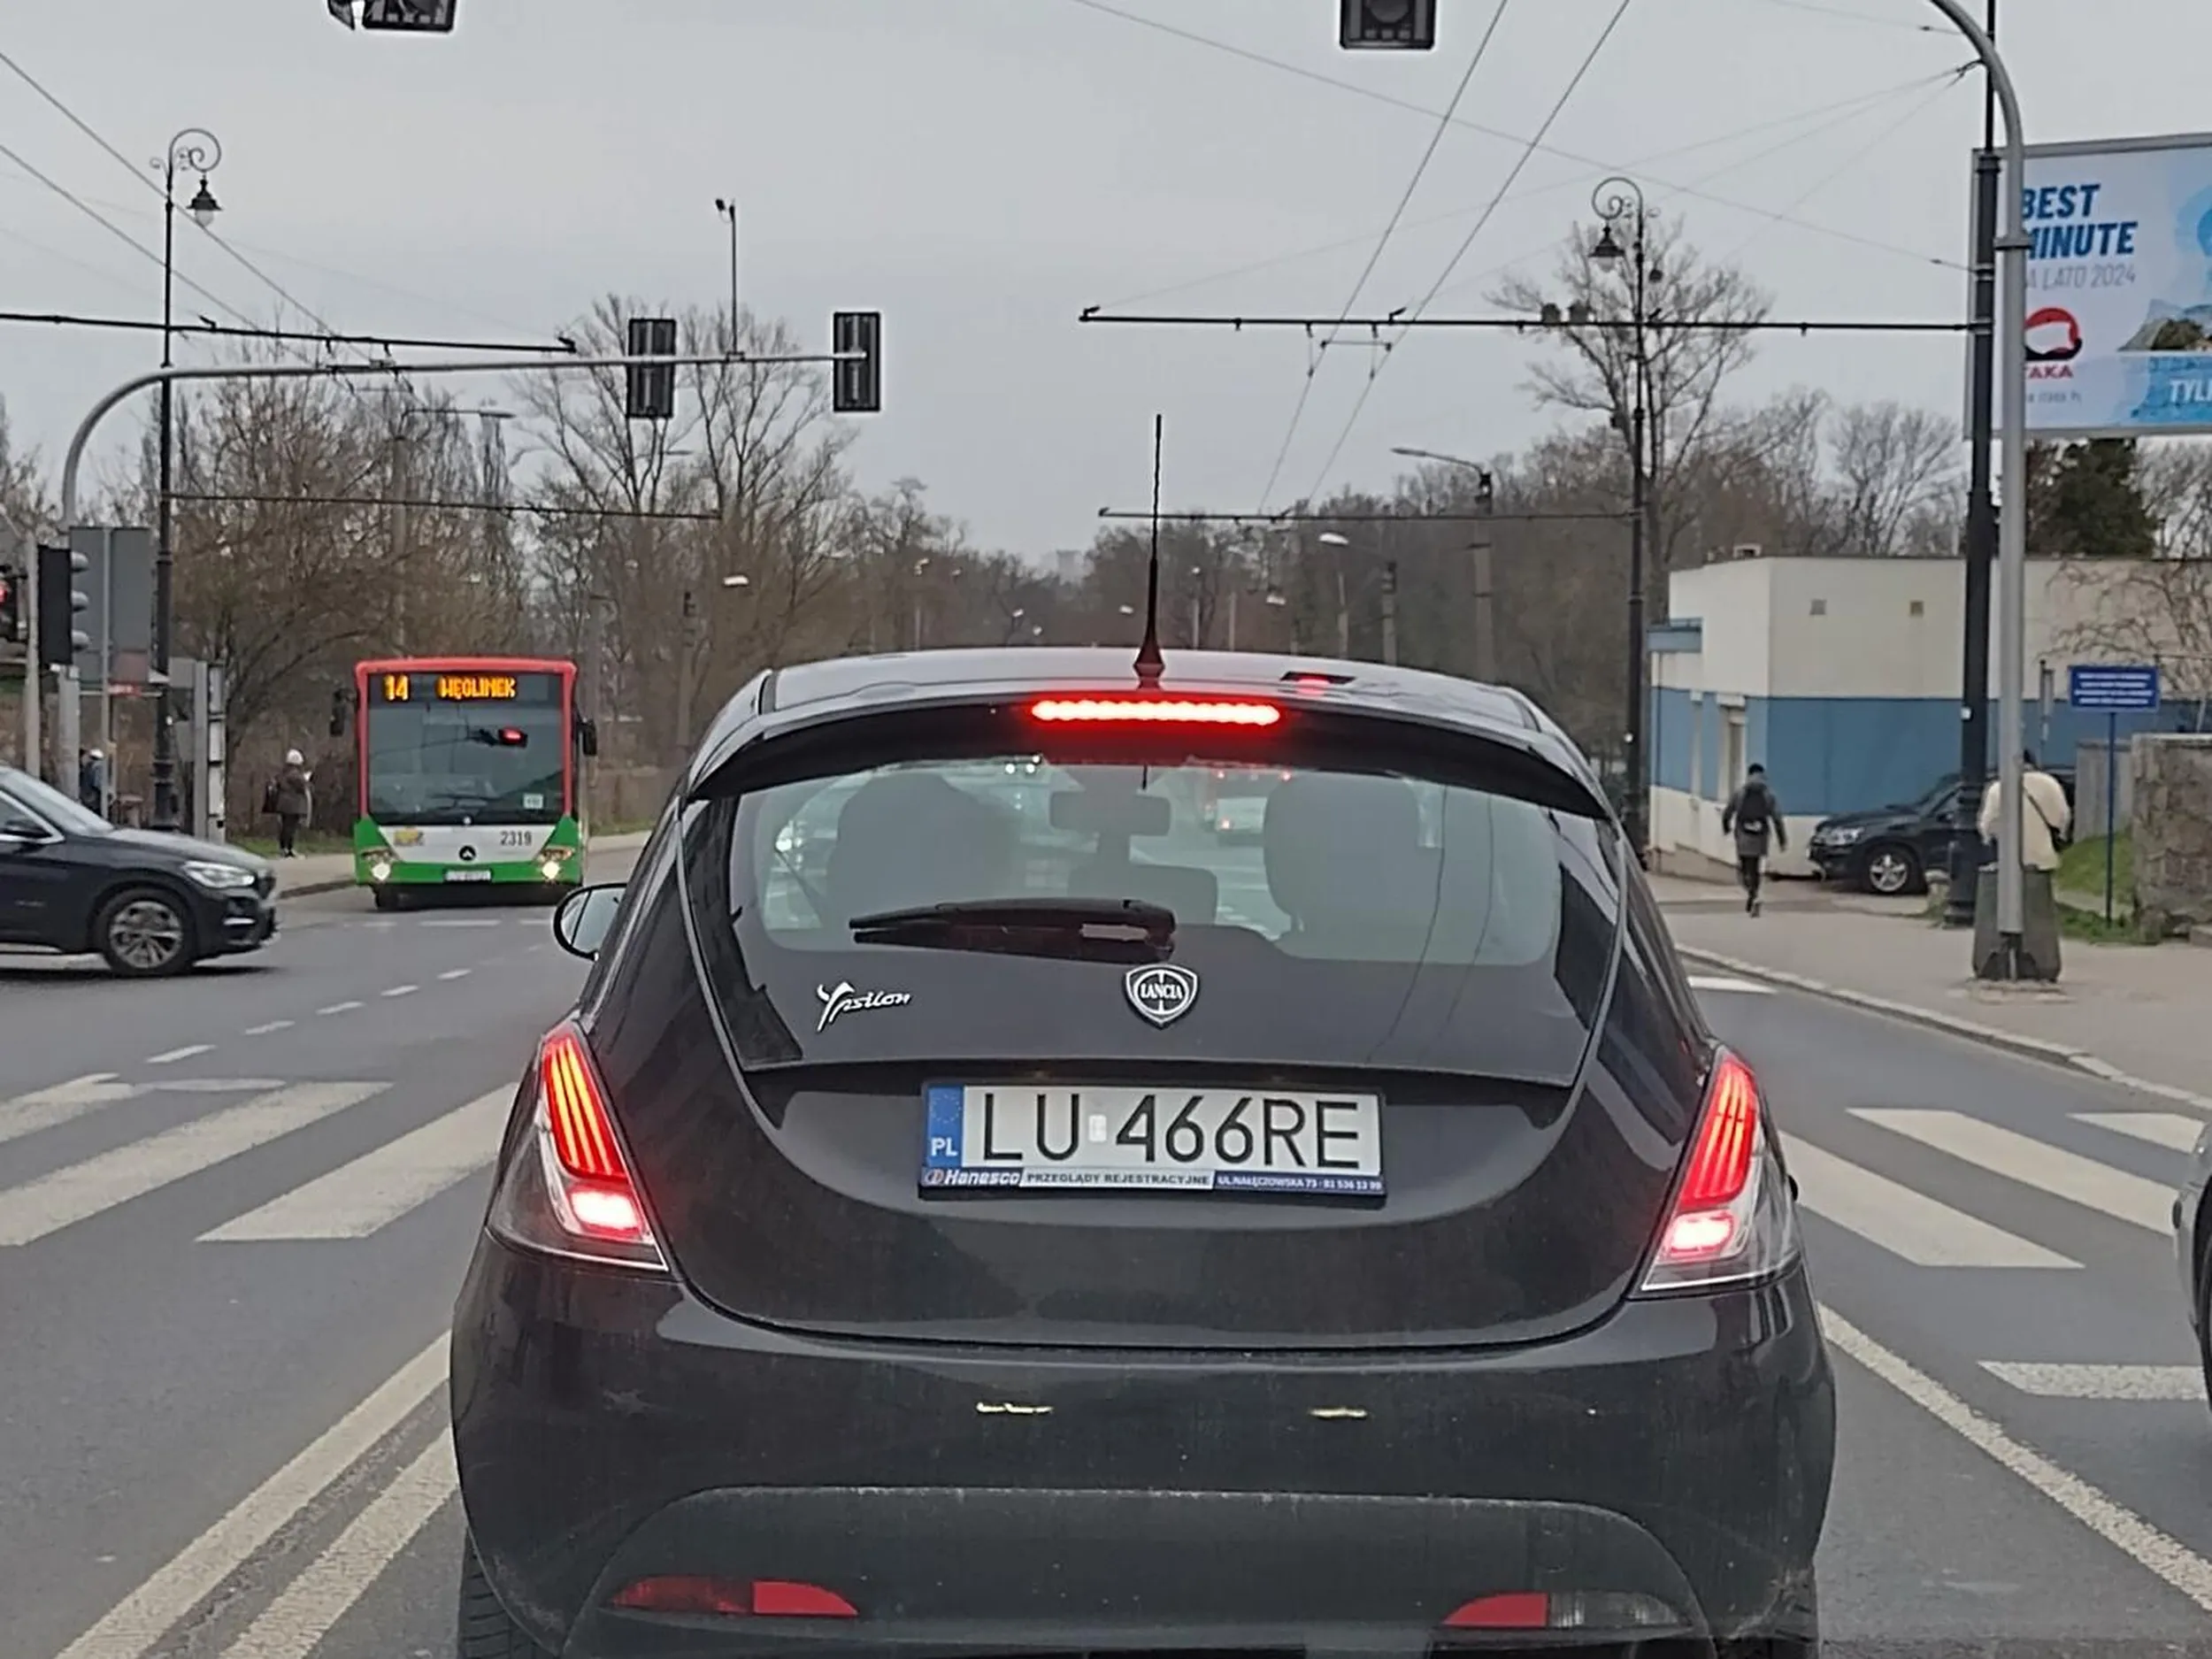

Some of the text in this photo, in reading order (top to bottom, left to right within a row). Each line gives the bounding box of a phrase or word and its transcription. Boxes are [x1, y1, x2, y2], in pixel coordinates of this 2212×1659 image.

[2090, 263, 2137, 288] 2024
[384, 675, 409, 700] 14
[500, 831, 532, 846] 2319
[1141, 982, 1183, 1000] LANCIA
[983, 1093, 1359, 1169] LU 466RE
[931, 1137, 958, 1156] PL
[1105, 1173, 1210, 1186] REJESTRACYJNE
